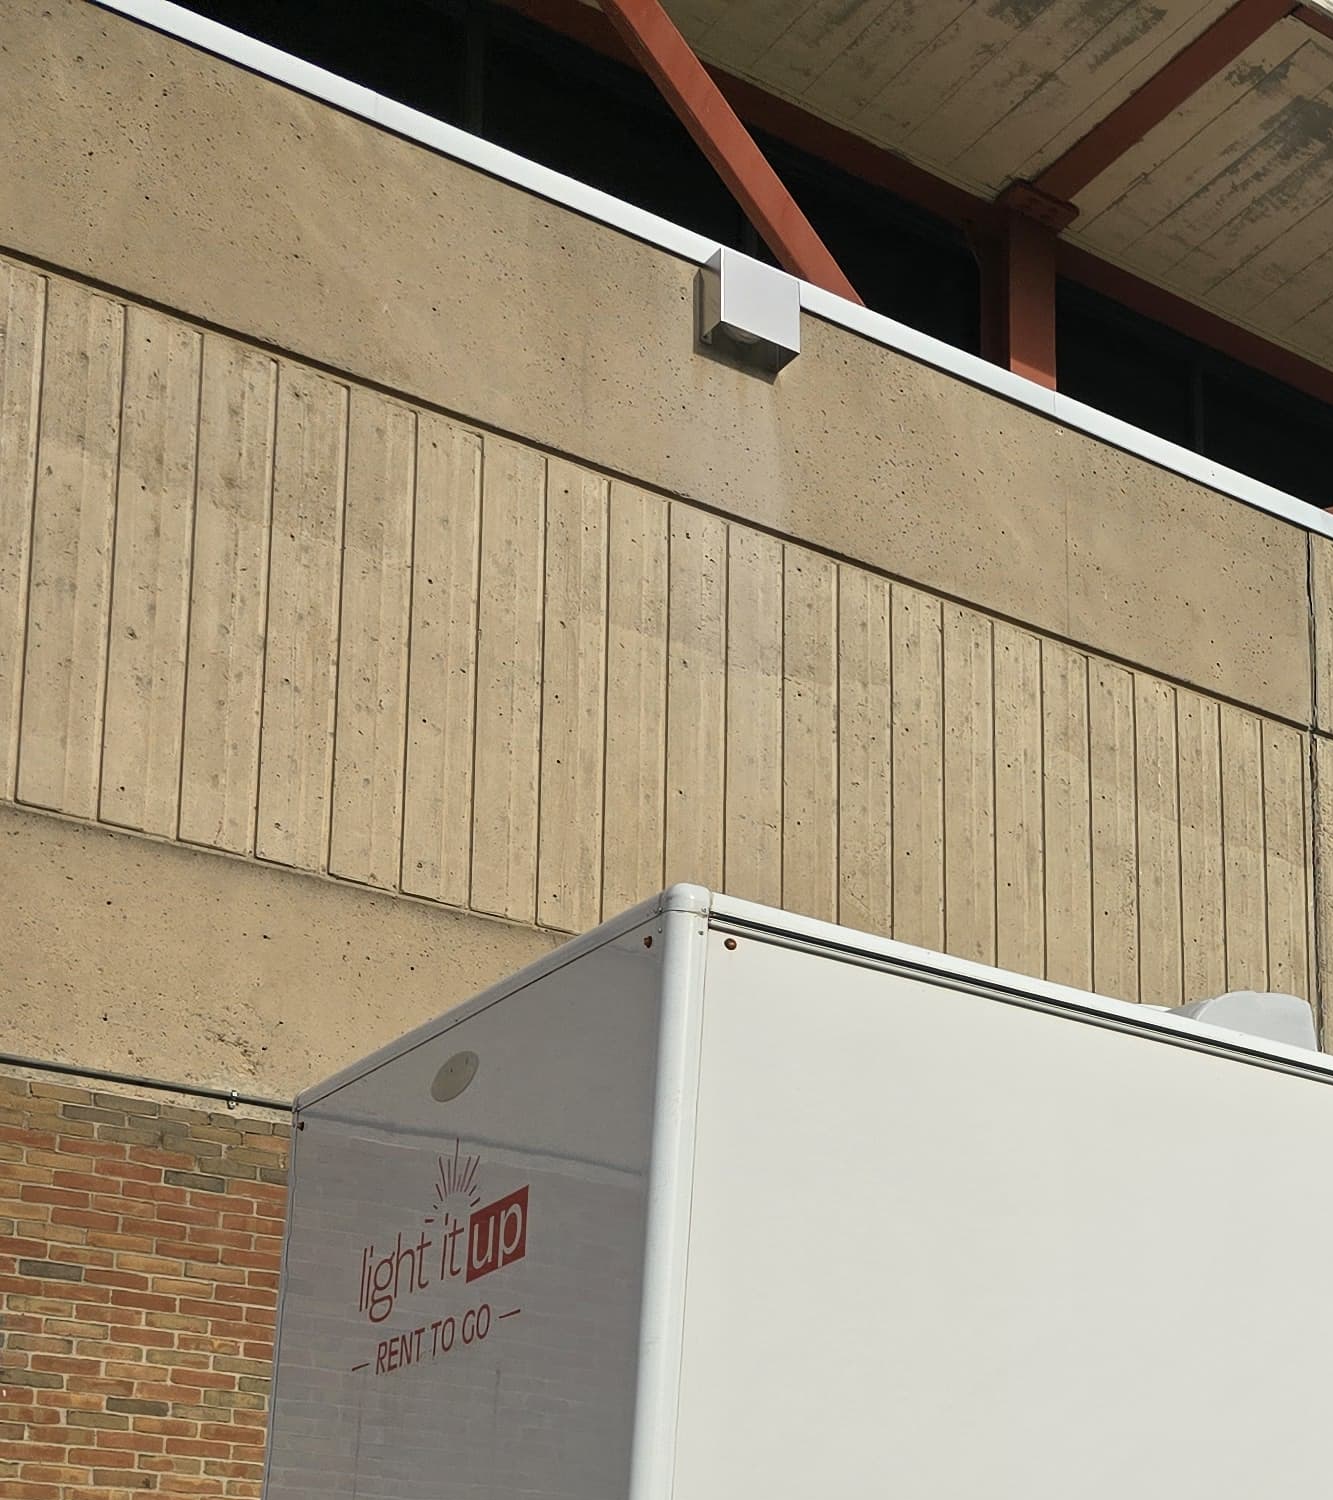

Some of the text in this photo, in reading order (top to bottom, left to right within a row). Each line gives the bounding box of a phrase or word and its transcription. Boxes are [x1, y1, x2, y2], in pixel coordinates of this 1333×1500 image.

[359, 1202, 524, 1323] light it up
[375, 1303, 491, 1375] RENT TO GO
